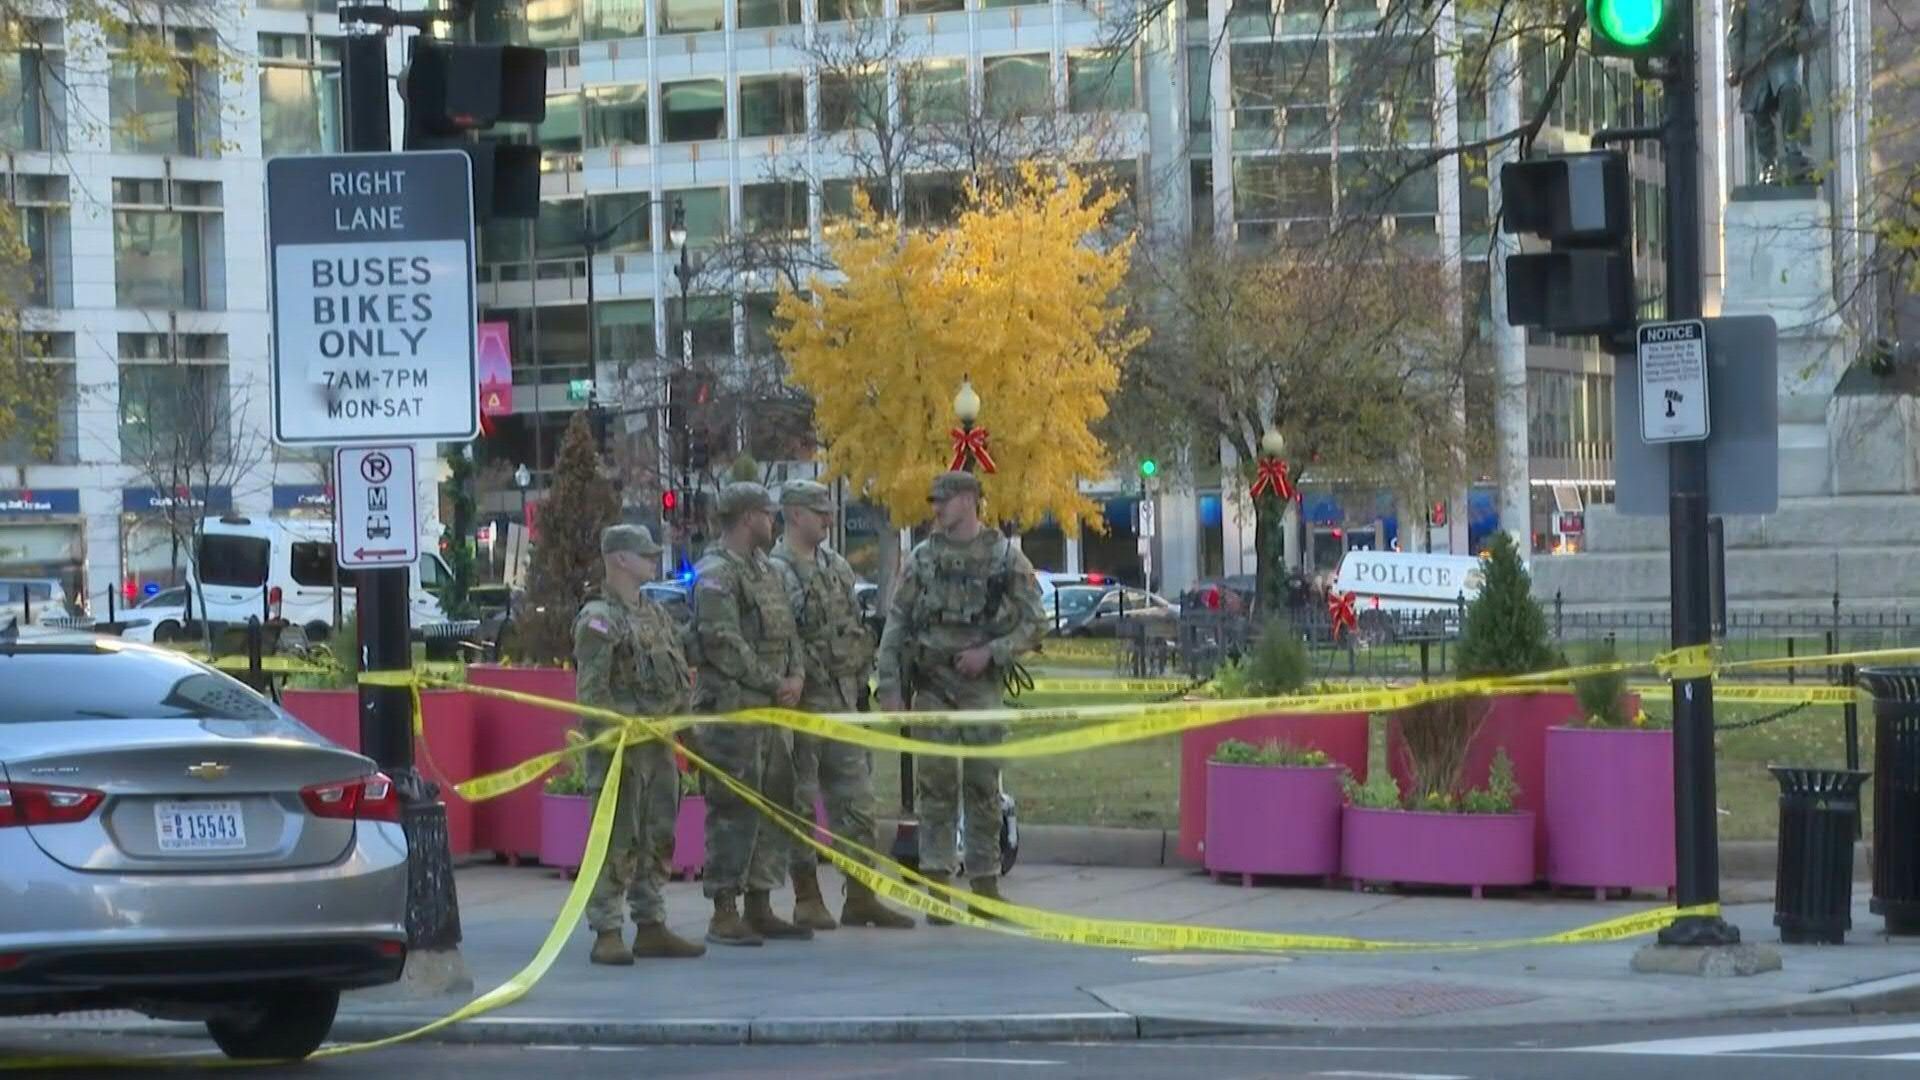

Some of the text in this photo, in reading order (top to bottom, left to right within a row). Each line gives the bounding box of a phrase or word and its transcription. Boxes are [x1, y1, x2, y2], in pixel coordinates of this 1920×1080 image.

[329, 171, 406, 196] RIGHT
[335, 206, 404, 231] LANE
[312, 256, 431, 288] BUSES
[313, 293, 433, 325] BIKES
[319, 327, 428, 358] ONLY
[1646, 325, 1694, 341] NOTICE
[322, 368, 428, 390] 7AM-7PM
[327, 398, 423, 419] MON-SAT
[1354, 562, 1451, 587] POLICE
[187, 814, 237, 839] 15543
